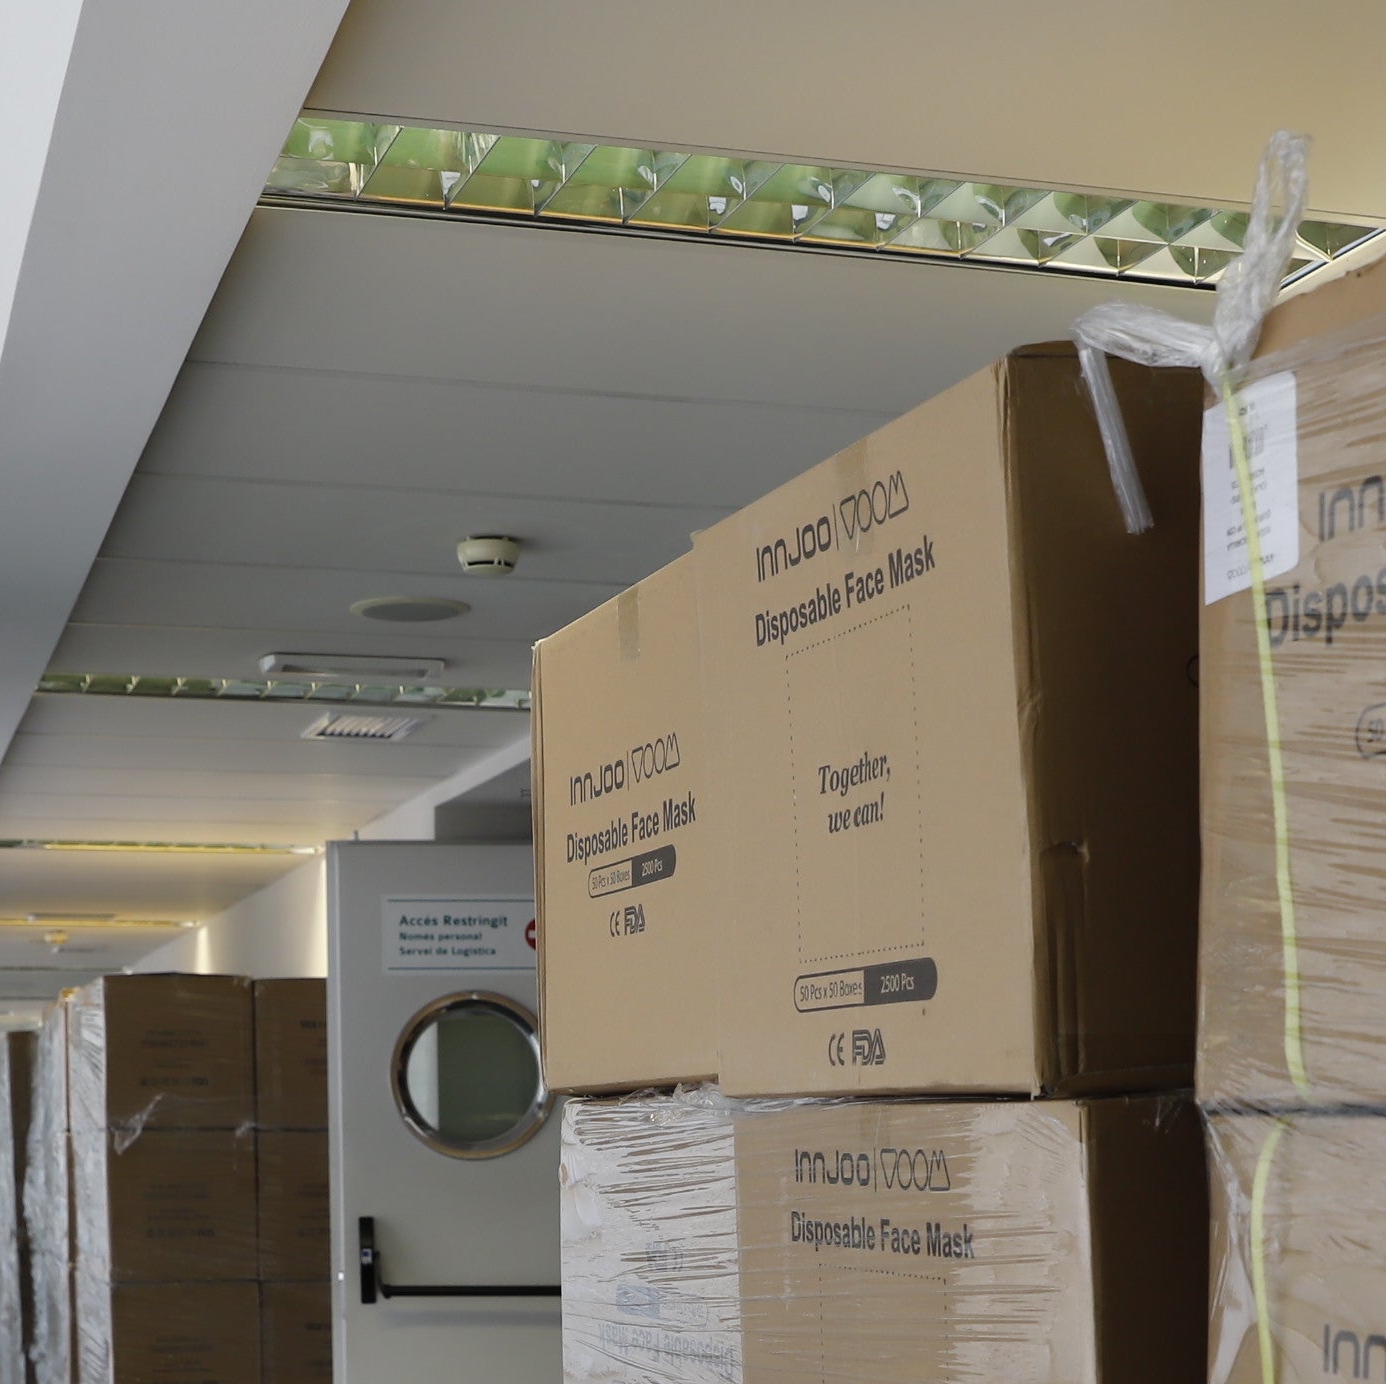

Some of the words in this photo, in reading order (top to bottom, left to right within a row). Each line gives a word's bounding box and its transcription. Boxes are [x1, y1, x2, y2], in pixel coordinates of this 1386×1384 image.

[755, 583, 841, 647] Disposable
[844, 567, 884, 609] Face
[888, 534, 935, 589] Mask
[818, 751, 891, 797] Together,
[566, 818, 628, 865] Disposable
[631, 810, 659, 843] Face
[663, 791, 696, 832] Mask
[828, 809, 851, 834] we
[853, 791, 885, 828] can!
[437, 932, 483, 943] personal
[443, 914, 508, 929] Restringit
[624, 903, 646, 936] FDA
[399, 946, 433, 956] Servei
[435, 946, 448, 956] de
[800, 985, 810, 1002] 50
[811, 983, 823, 1001] Pcs
[829, 982, 839, 999] 50
[840, 978, 862, 998] Boxes
[880, 975, 899, 994] 2500
[901, 972, 915, 991] Pcs
[852, 1028, 886, 1067] FDA
[790, 1211, 875, 1251] Disposable
[880, 1218, 921, 1255] Face
[926, 1221, 975, 1259] Mask
